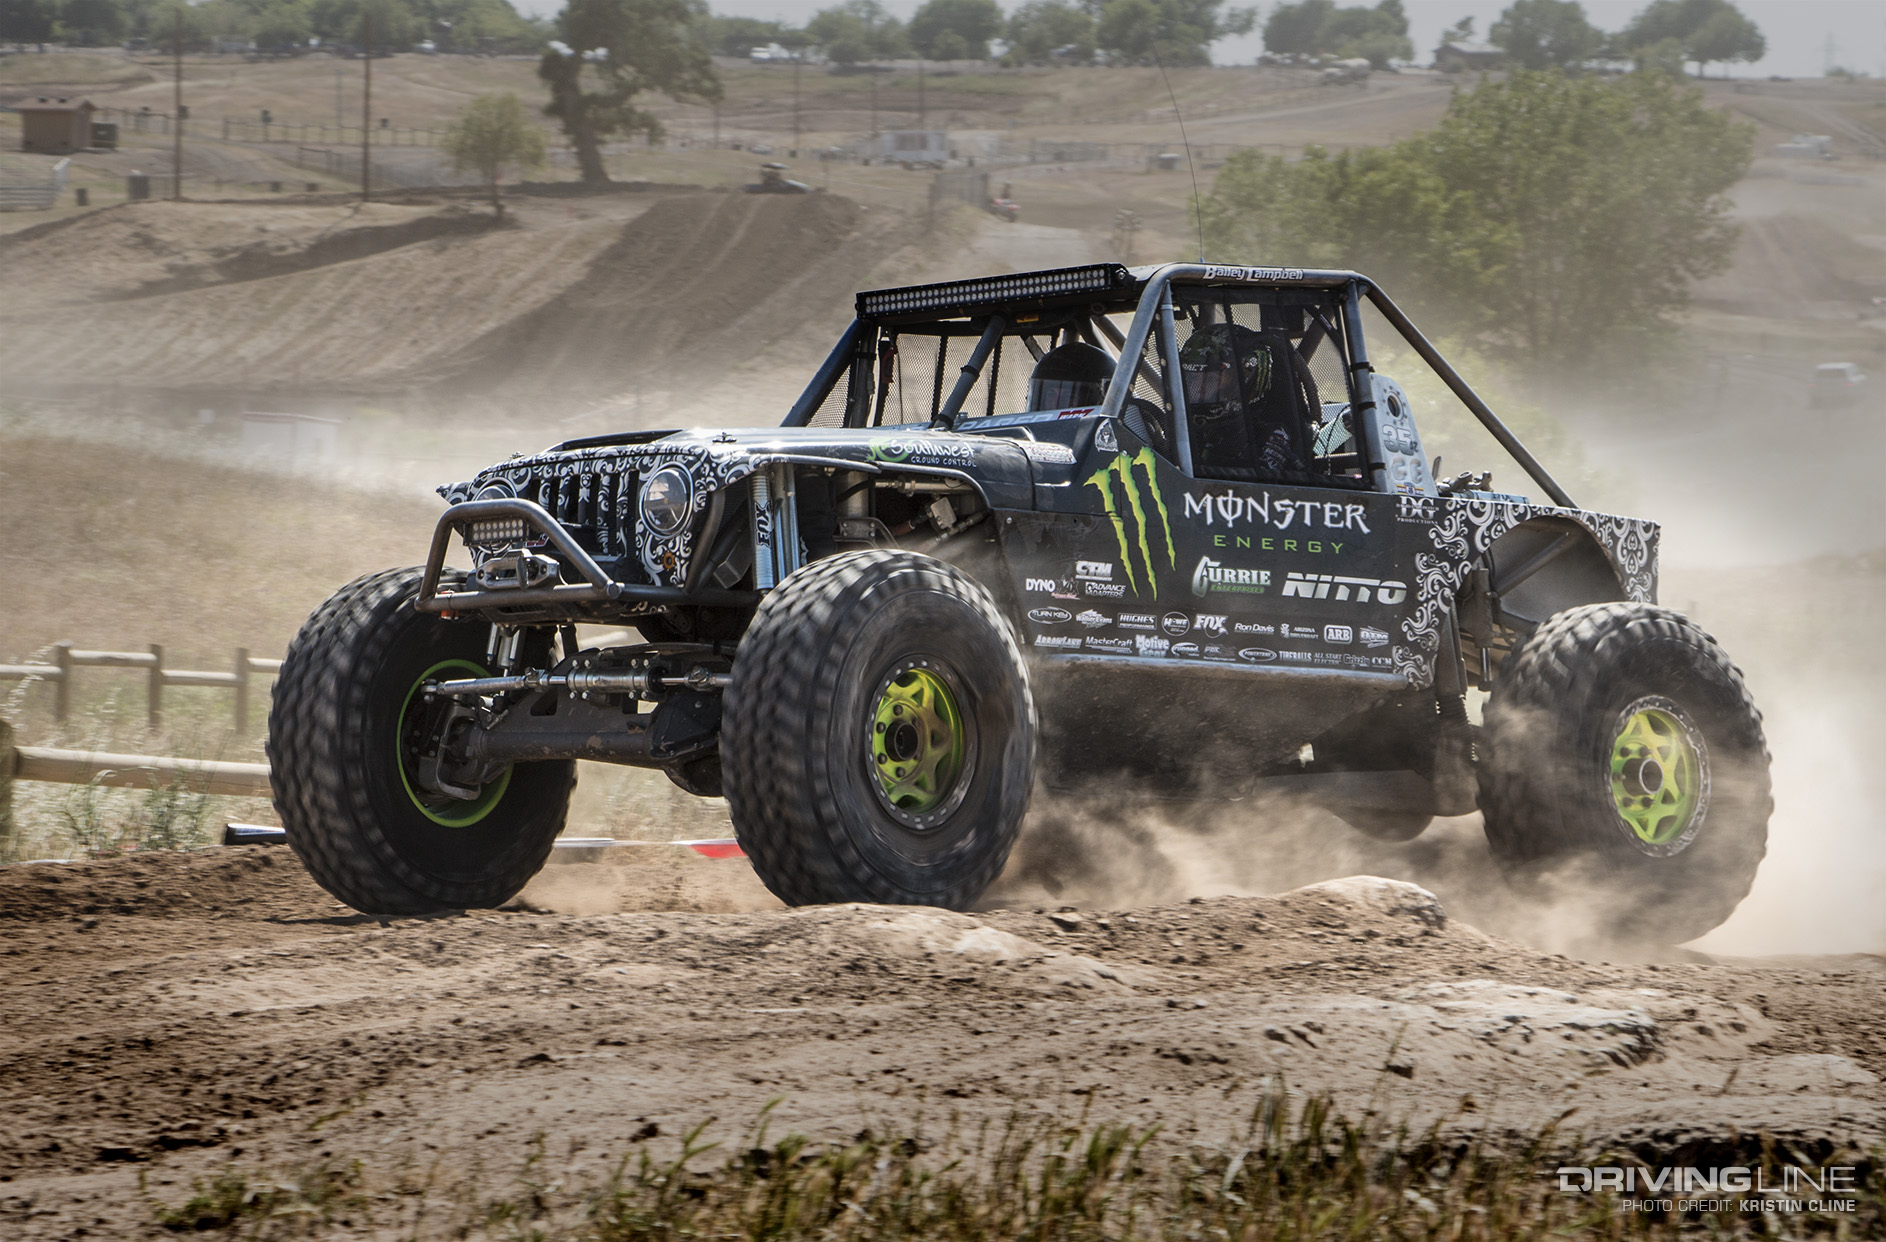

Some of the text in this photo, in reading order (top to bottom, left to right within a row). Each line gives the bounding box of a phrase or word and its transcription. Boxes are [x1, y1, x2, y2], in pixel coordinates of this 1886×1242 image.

[1203, 265, 1303, 282] Bailey Campbell
[890, 439, 976, 459] Southwest
[1382, 423, 1415, 457] 35
[911, 456, 977, 468] GROUND CONTROL
[1183, 489, 1371, 534] MONSTER
[1400, 496, 1436, 520] DG
[755, 500, 772, 548] FOX
[1213, 534, 1344, 554] ENERGY
[1076, 561, 1113, 576] CTM
[1191, 555, 1271, 598] CURRIE
[1281, 571, 1407, 605] NITTO
[1119, 614, 1155, 624] HUGHES
[1194, 613, 1229, 632] FOX
[1234, 622, 1252, 631] Ron
[1252, 623, 1275, 633] Davis
[1135, 634, 1170, 649] Motive
[1327, 628, 1351, 640] ARB
[1371, 656, 1393, 665] CCM
